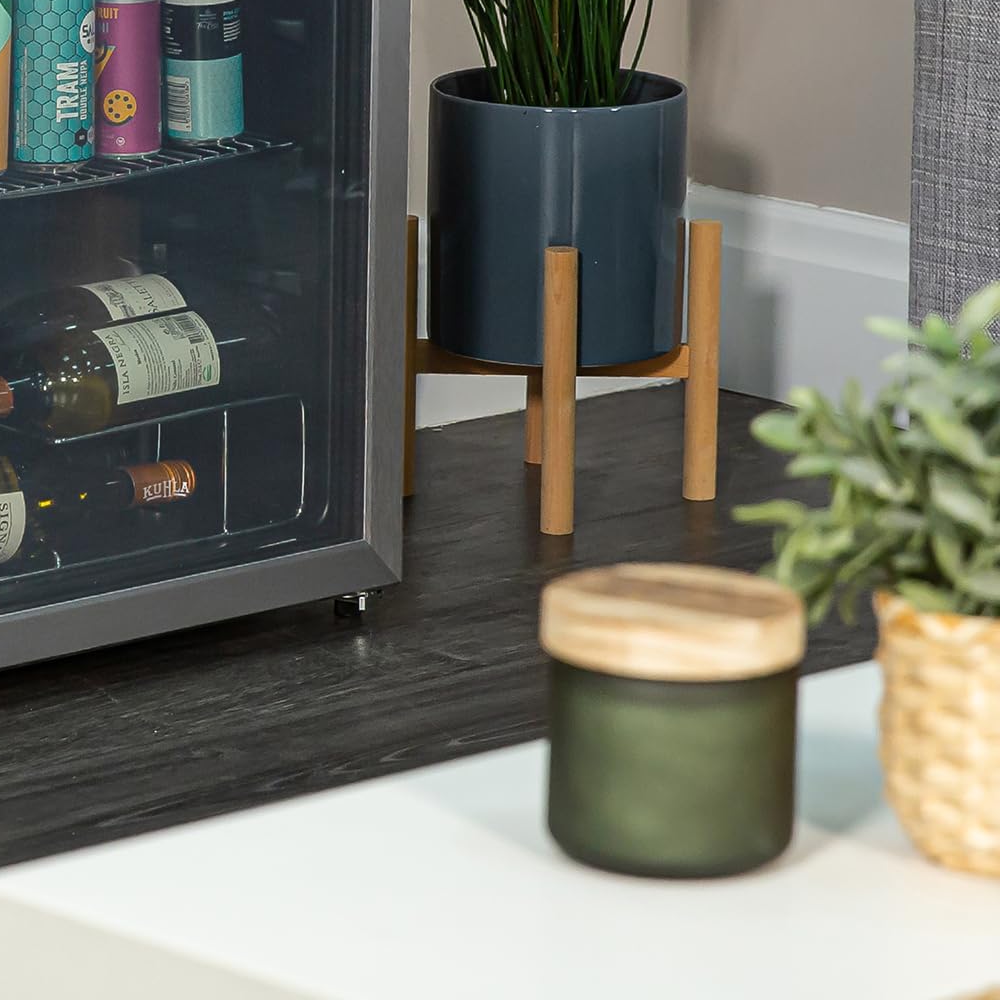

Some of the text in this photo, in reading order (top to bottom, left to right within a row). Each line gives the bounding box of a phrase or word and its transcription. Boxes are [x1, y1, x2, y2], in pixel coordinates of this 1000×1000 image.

[56, 61, 79, 123] TRAM
[105, 334, 131, 396] ISLA NEGRA
